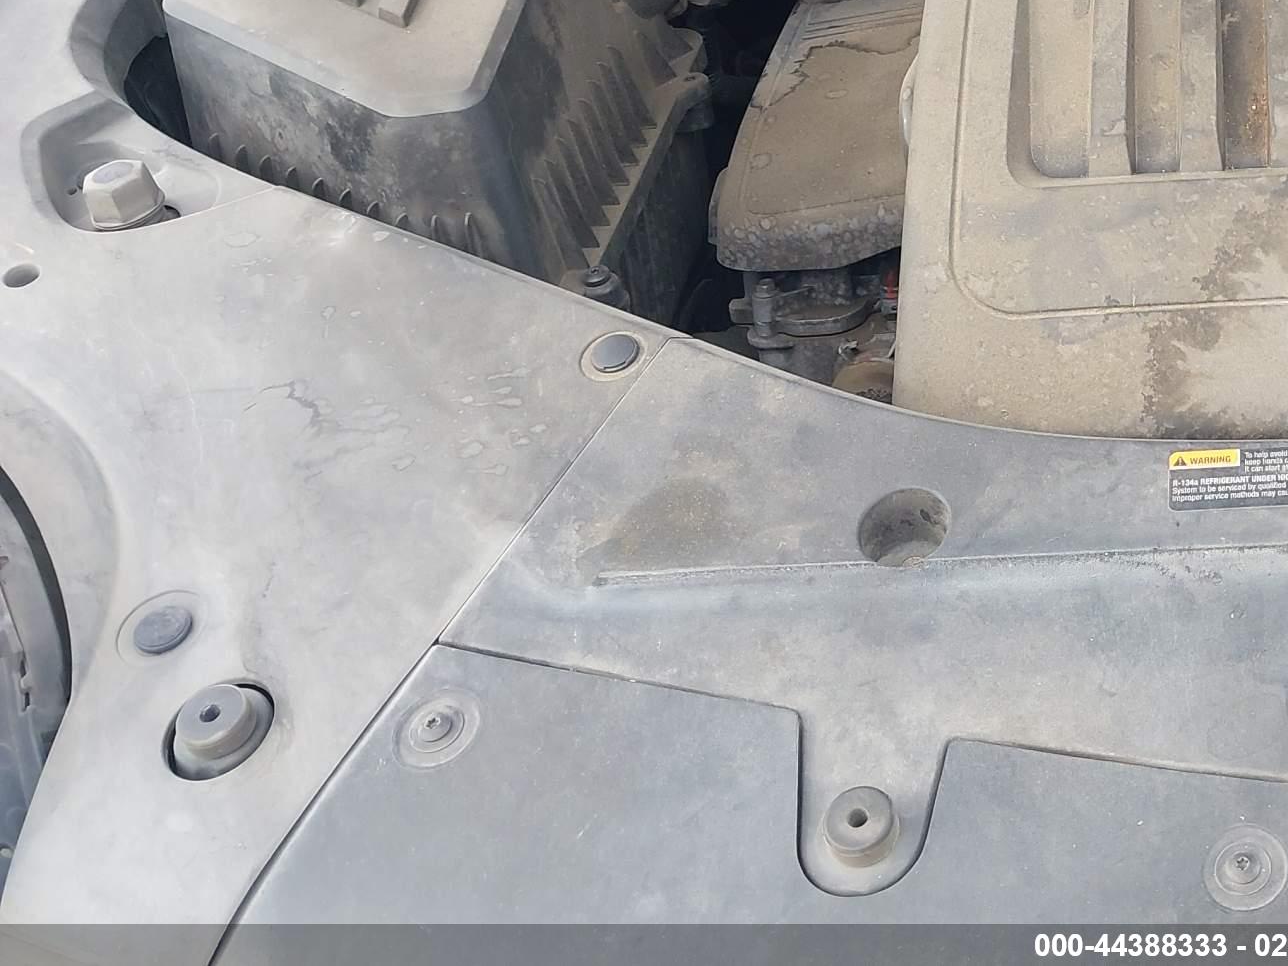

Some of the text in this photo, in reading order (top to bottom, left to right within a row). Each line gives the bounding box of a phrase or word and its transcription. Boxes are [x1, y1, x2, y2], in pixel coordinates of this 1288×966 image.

[1190, 455, 1231, 464] WARNING
[1245, 458, 1261, 466] keep
[1200, 476, 1250, 485] REFRIGERANT
[1252, 474, 1277, 483] UNDER
[1172, 486, 1198, 495] System
[1217, 483, 1246, 491] serviced
[1248, 483, 1257, 491] by
[1172, 494, 1202, 502] Improper
[1204, 492, 1229, 500] service
[1230, 490, 1259, 498] methods
[1261, 490, 1276, 498] may
